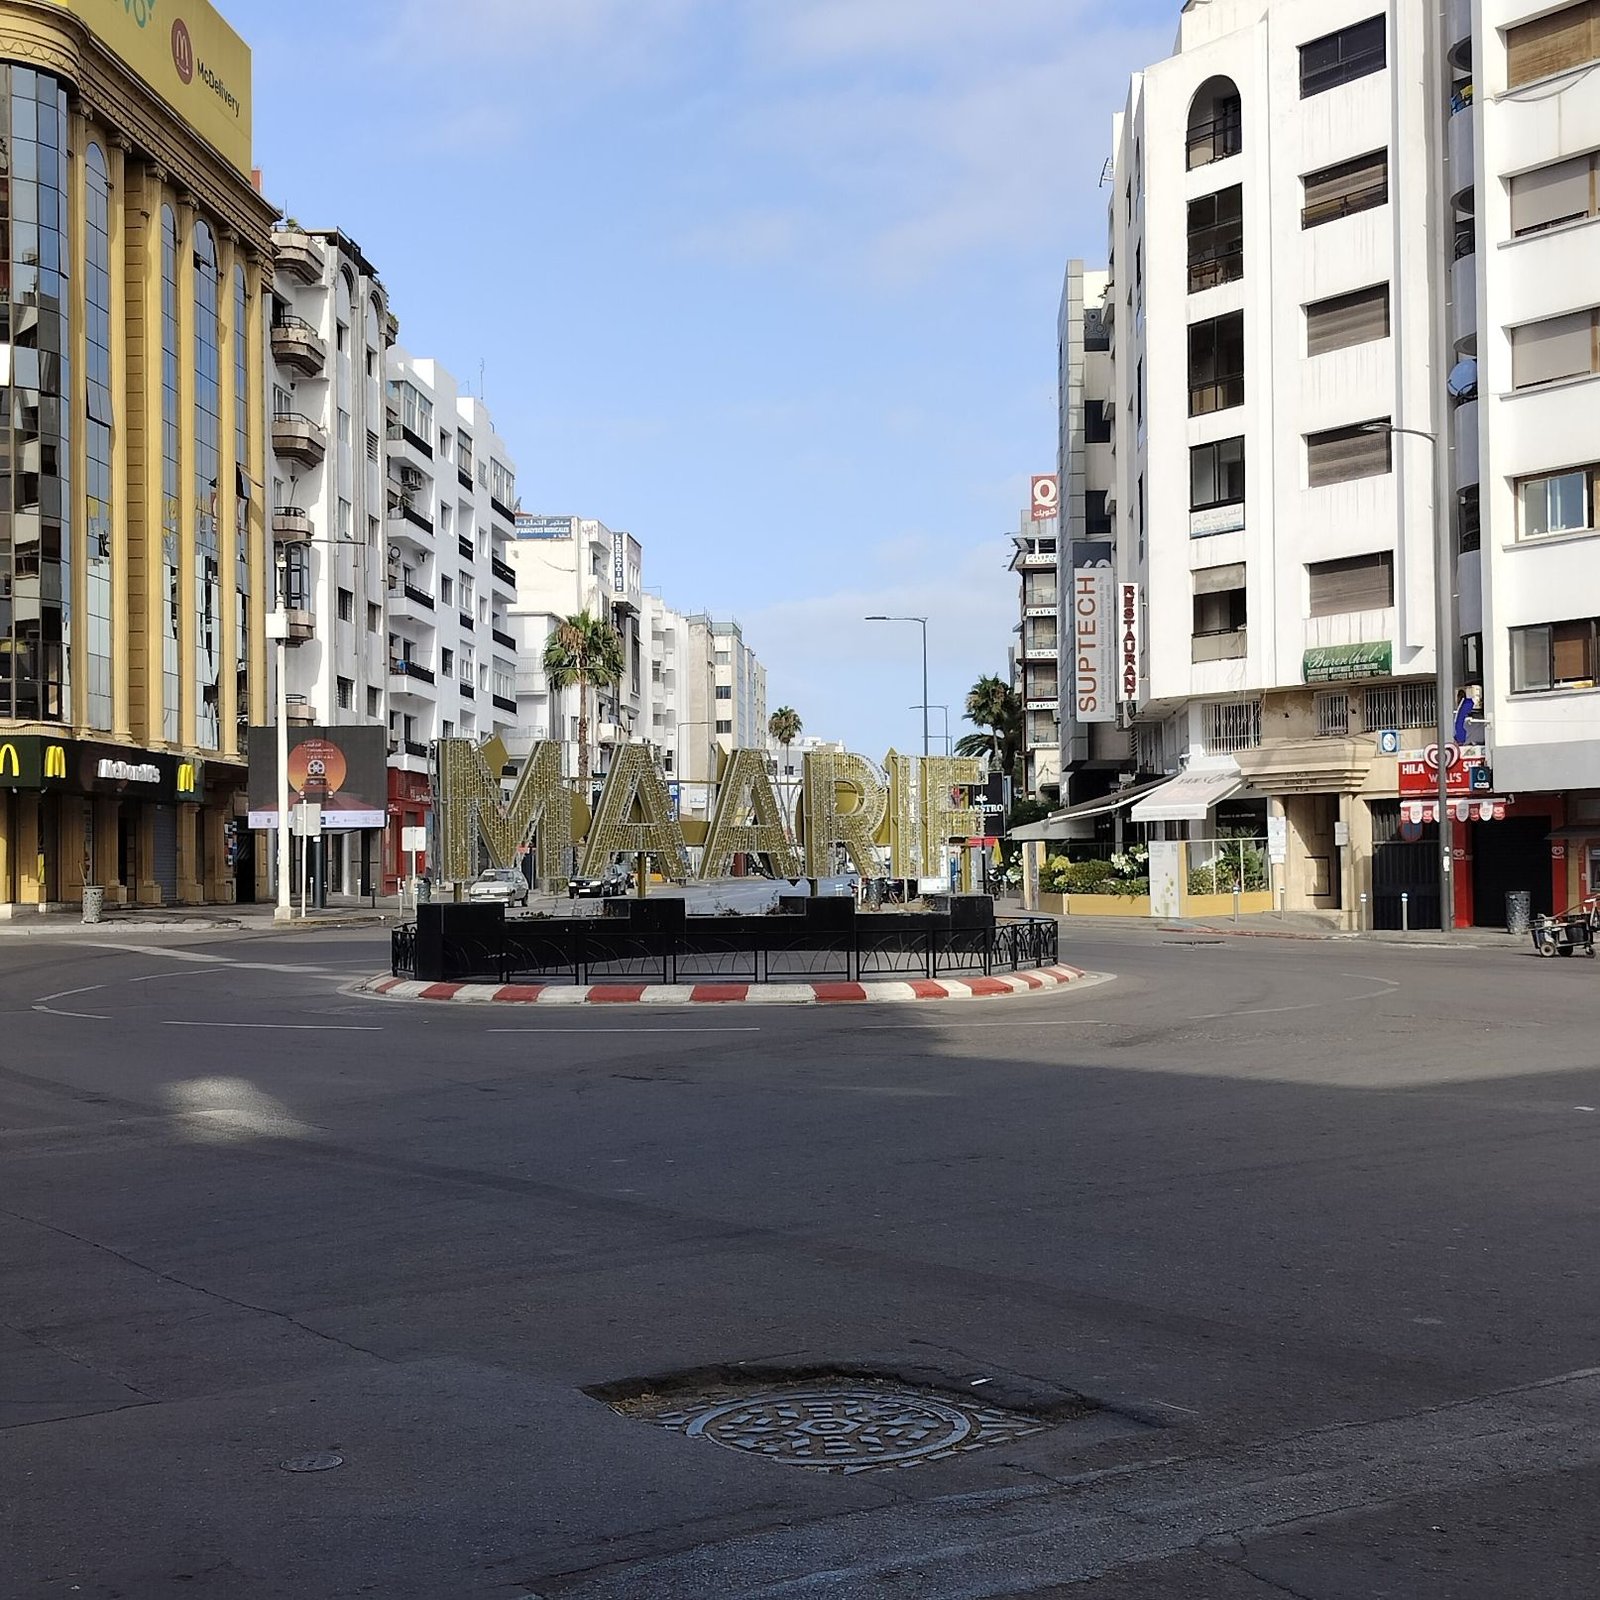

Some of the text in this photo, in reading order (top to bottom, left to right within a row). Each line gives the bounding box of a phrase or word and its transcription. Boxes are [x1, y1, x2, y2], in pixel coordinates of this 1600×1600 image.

[196, 57, 240, 118] McDelivery
[1033, 479, 1058, 507] Q
[1077, 576, 1097, 713] SUPTECH
[1122, 585, 1136, 700] RESTAURANT
[97, 758, 161, 783] McDonald's
[1402, 764, 1425, 774] HILA
[1429, 773, 1462, 783] WL'S
[438, 738, 988, 883] MAARIF
